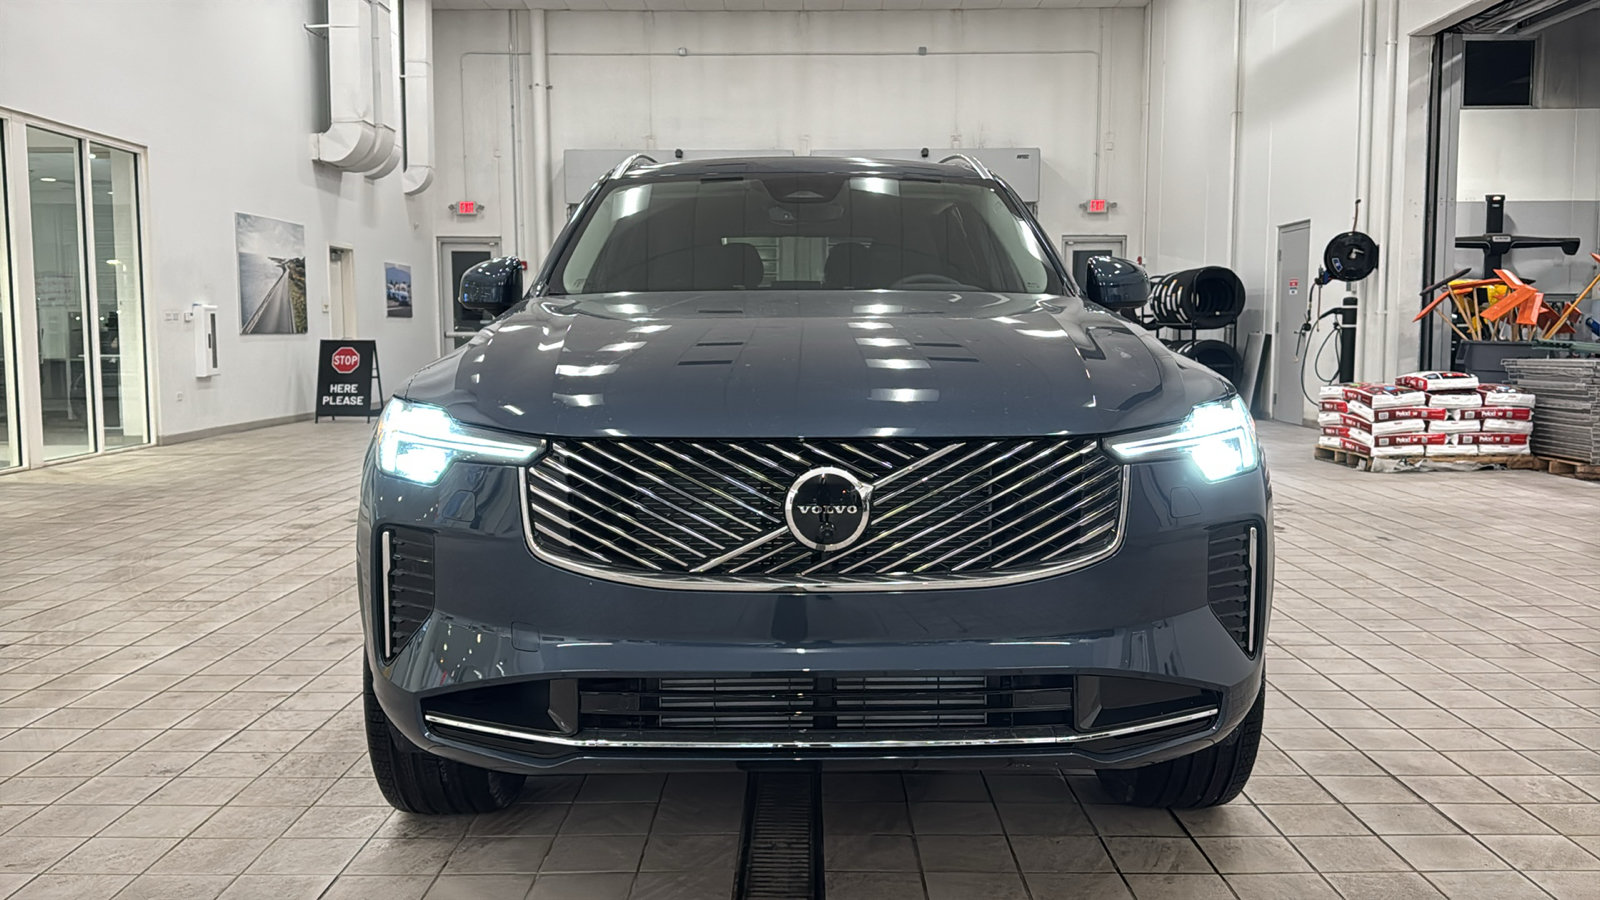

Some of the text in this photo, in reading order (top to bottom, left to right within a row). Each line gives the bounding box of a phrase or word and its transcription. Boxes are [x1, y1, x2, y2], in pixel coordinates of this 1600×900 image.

[334, 355, 358, 366] STOP
[329, 384, 359, 394] HERE
[322, 396, 365, 406] PLEASE
[797, 505, 858, 514] VOLVO
